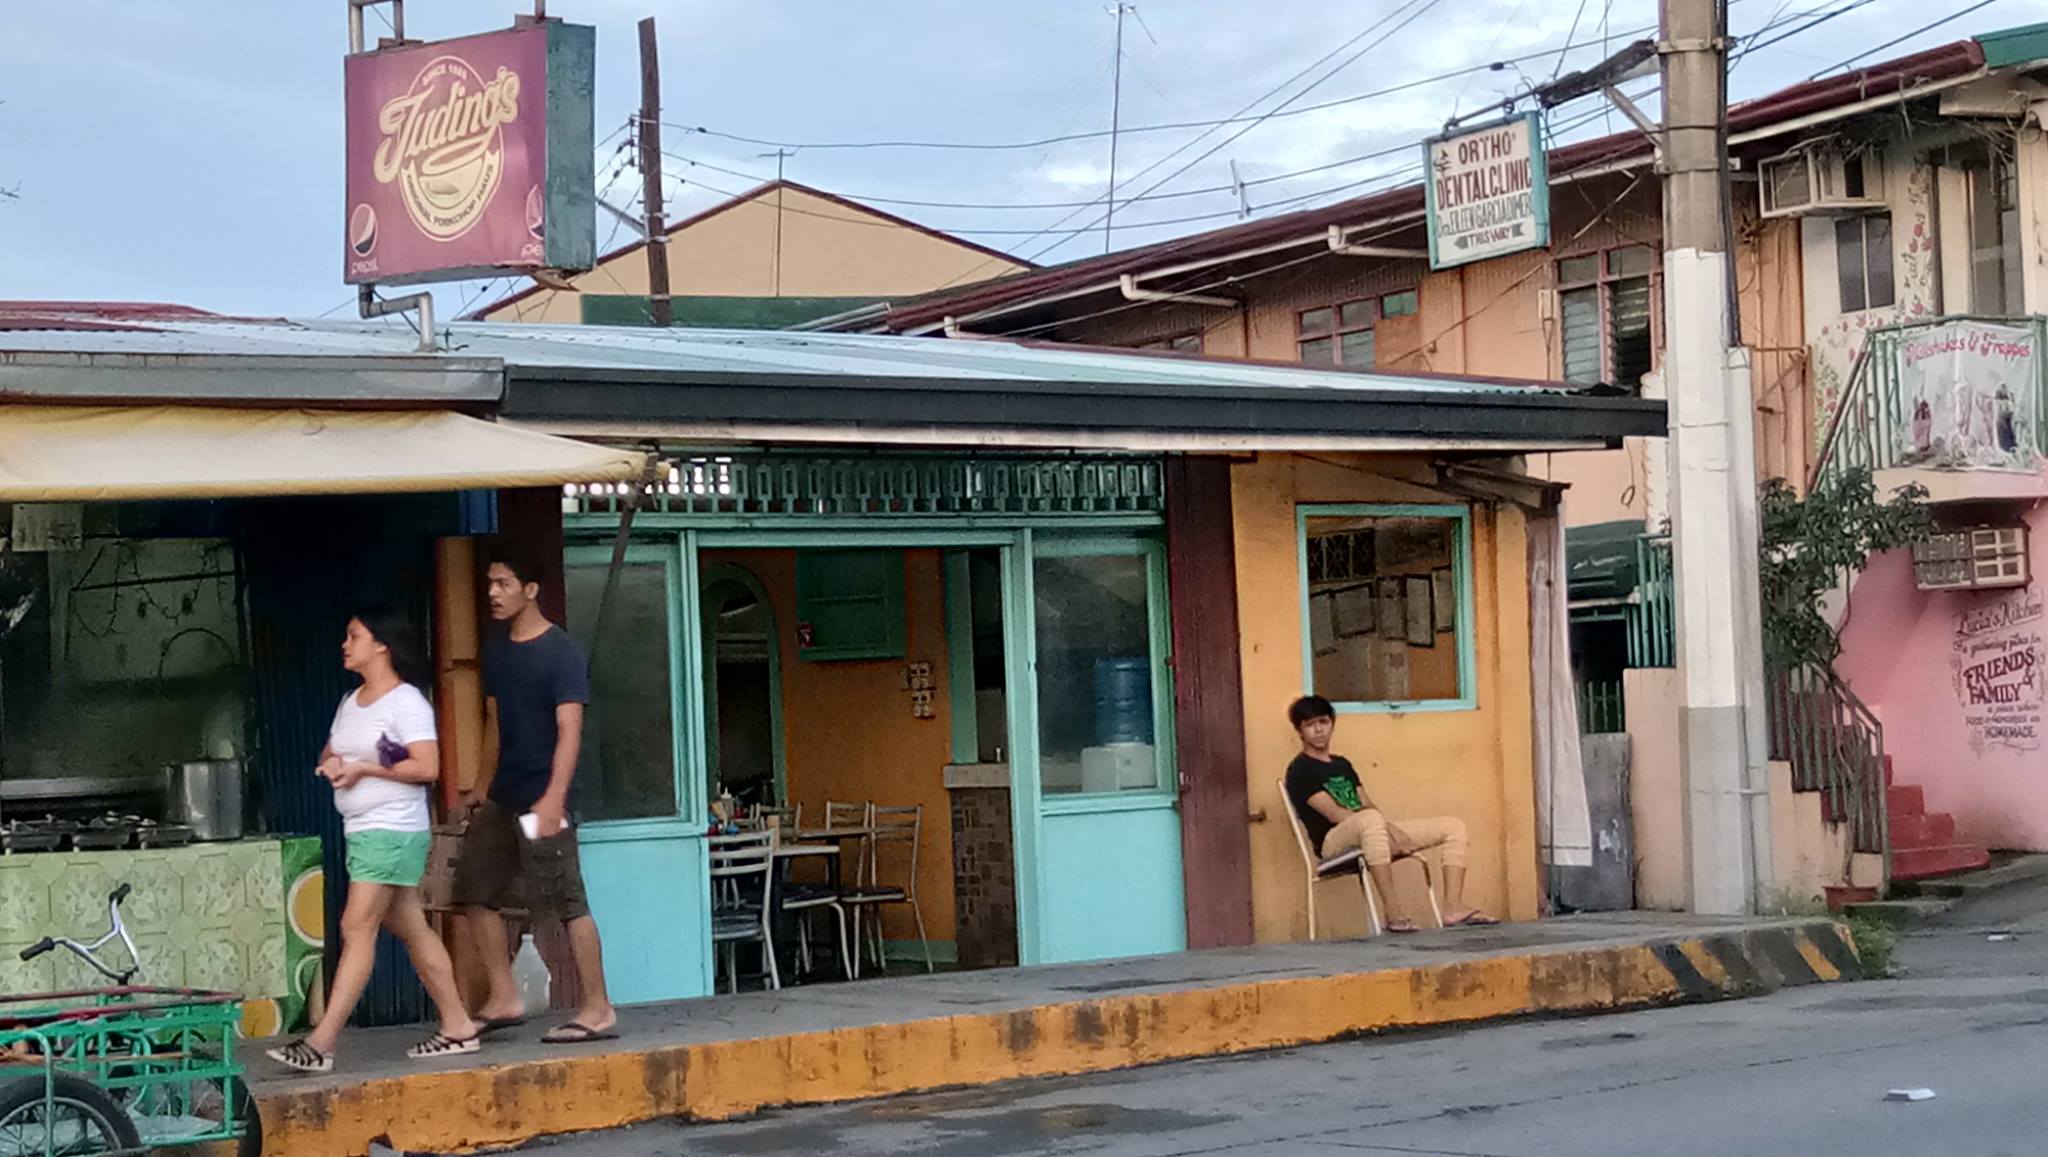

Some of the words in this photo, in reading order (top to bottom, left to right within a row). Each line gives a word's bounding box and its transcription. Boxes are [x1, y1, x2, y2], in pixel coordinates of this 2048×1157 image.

[1436, 170, 1490, 211] DENTAL
[1490, 157, 1532, 197] CLINIC
[433, 199, 476, 227] PORKCHOP
[1469, 231, 1491, 247] THIS
[1491, 225, 1511, 243] WAY
[1963, 646, 2035, 688] FRIENDS
[2022, 666, 2036, 690] &
[1969, 684, 2024, 706] FAMILY
